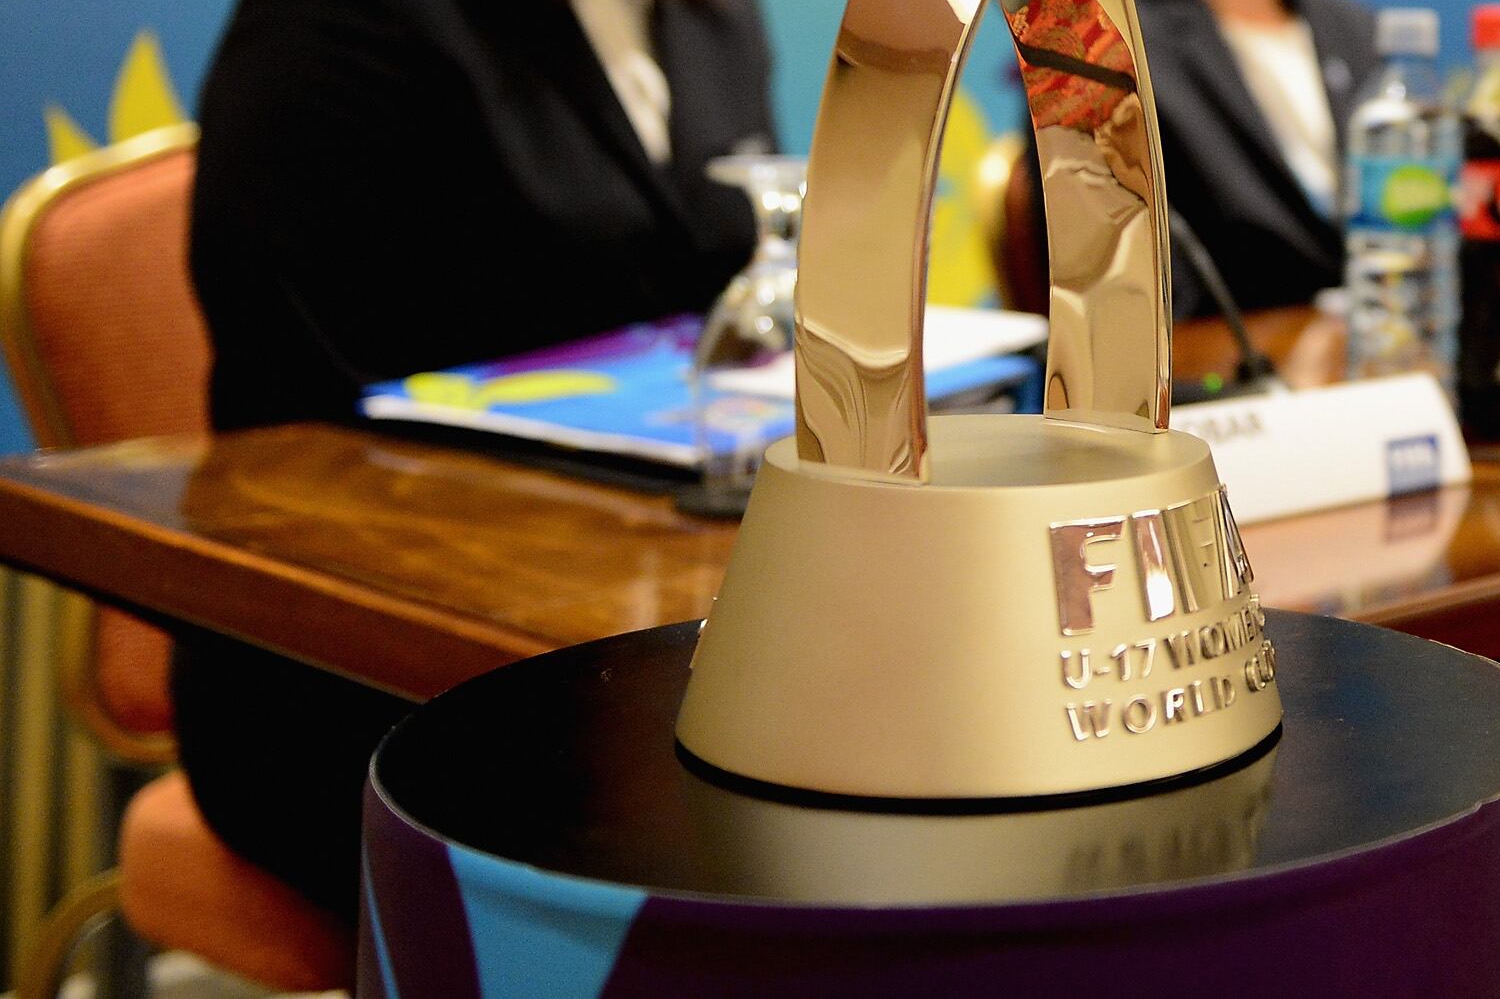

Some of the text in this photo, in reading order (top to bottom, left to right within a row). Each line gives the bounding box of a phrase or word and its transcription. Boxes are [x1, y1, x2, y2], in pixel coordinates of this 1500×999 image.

[1049, 484, 1254, 636] FIFA
[1060, 638, 1156, 689] U-17
[1066, 639, 1275, 741] WORLD CU
